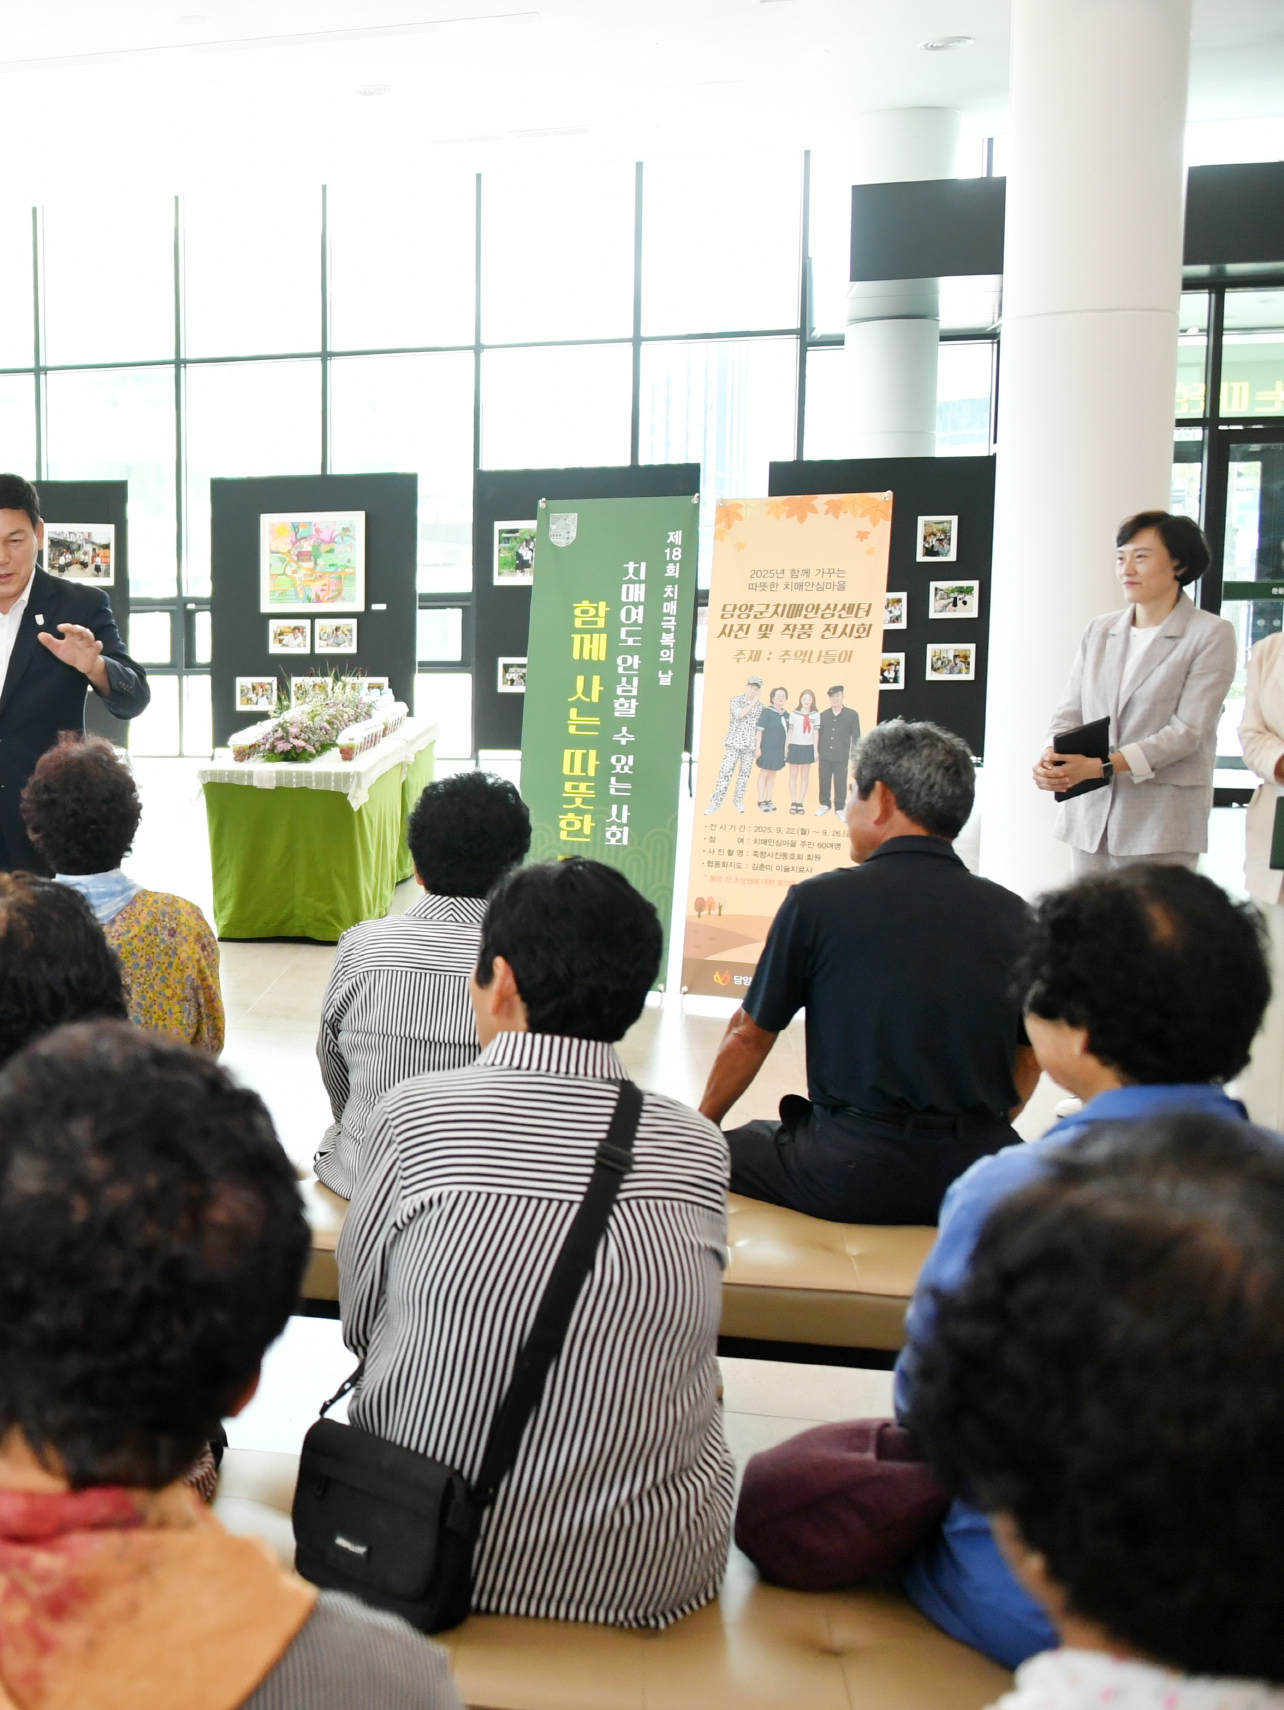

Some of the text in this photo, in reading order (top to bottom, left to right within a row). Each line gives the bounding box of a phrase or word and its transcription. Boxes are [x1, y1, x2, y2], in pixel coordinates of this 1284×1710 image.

[749, 567, 847, 579] 2025년 함께 가꾸는
[748, 581, 847, 592] 따뜻한 치매안심마을
[658, 530, 682, 685] 제18회 치매극복의 날
[720, 602, 873, 620] 담양군치매안심센터
[571, 600, 611, 661] 함께
[716, 623, 873, 640] 사진 및 작품 전시회
[732, 649, 762, 663] 주제
[777, 649, 854, 664] 추억나들이
[567, 674, 604, 735] 사는
[604, 561, 647, 846] 치매여도 안심할 수 있는 사회
[558, 748, 600, 842] 따뜻한
[754, 825, 774, 834] 2025.
[753, 838, 797, 848] 치매안심마을
[800, 840, 815, 849] 주민
[817, 841, 842, 850] 60여명
[806, 853, 822, 862] 회원
[776, 865, 813, 874] 미술치료사
